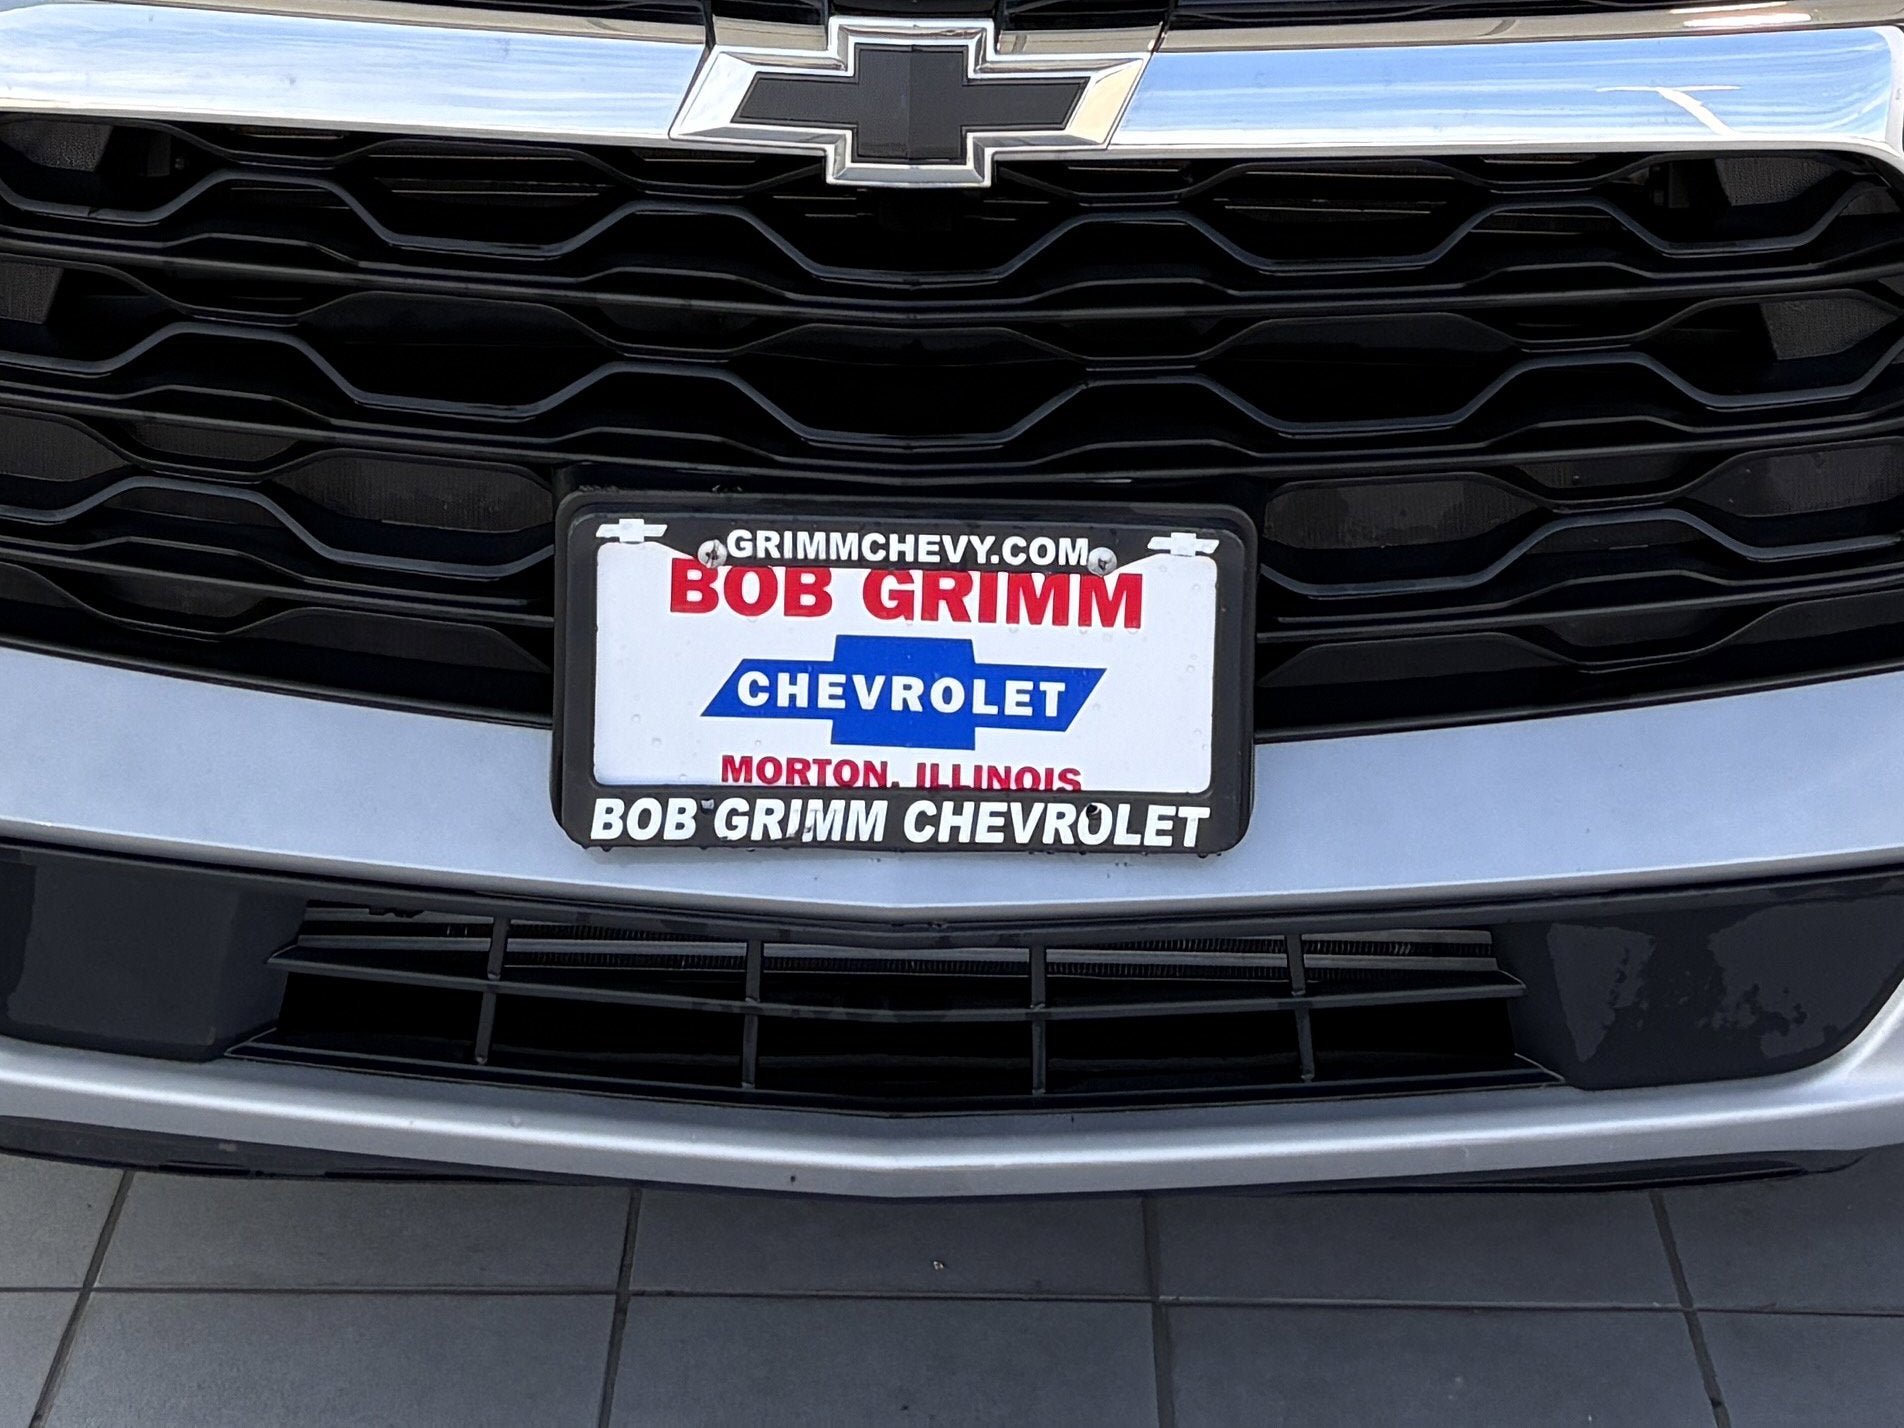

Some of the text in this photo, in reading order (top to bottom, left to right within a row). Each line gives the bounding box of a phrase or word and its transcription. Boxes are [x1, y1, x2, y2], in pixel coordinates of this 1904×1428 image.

[726, 528, 1089, 567] GRIMMCHEVY.COM
[669, 557, 1143, 630] BOB GRIMM
[736, 670, 1066, 719] CHEVROLET
[915, 762, 1083, 792] ILLINOIS
[590, 797, 1211, 848] BOB GRIMM CHEVROLET
